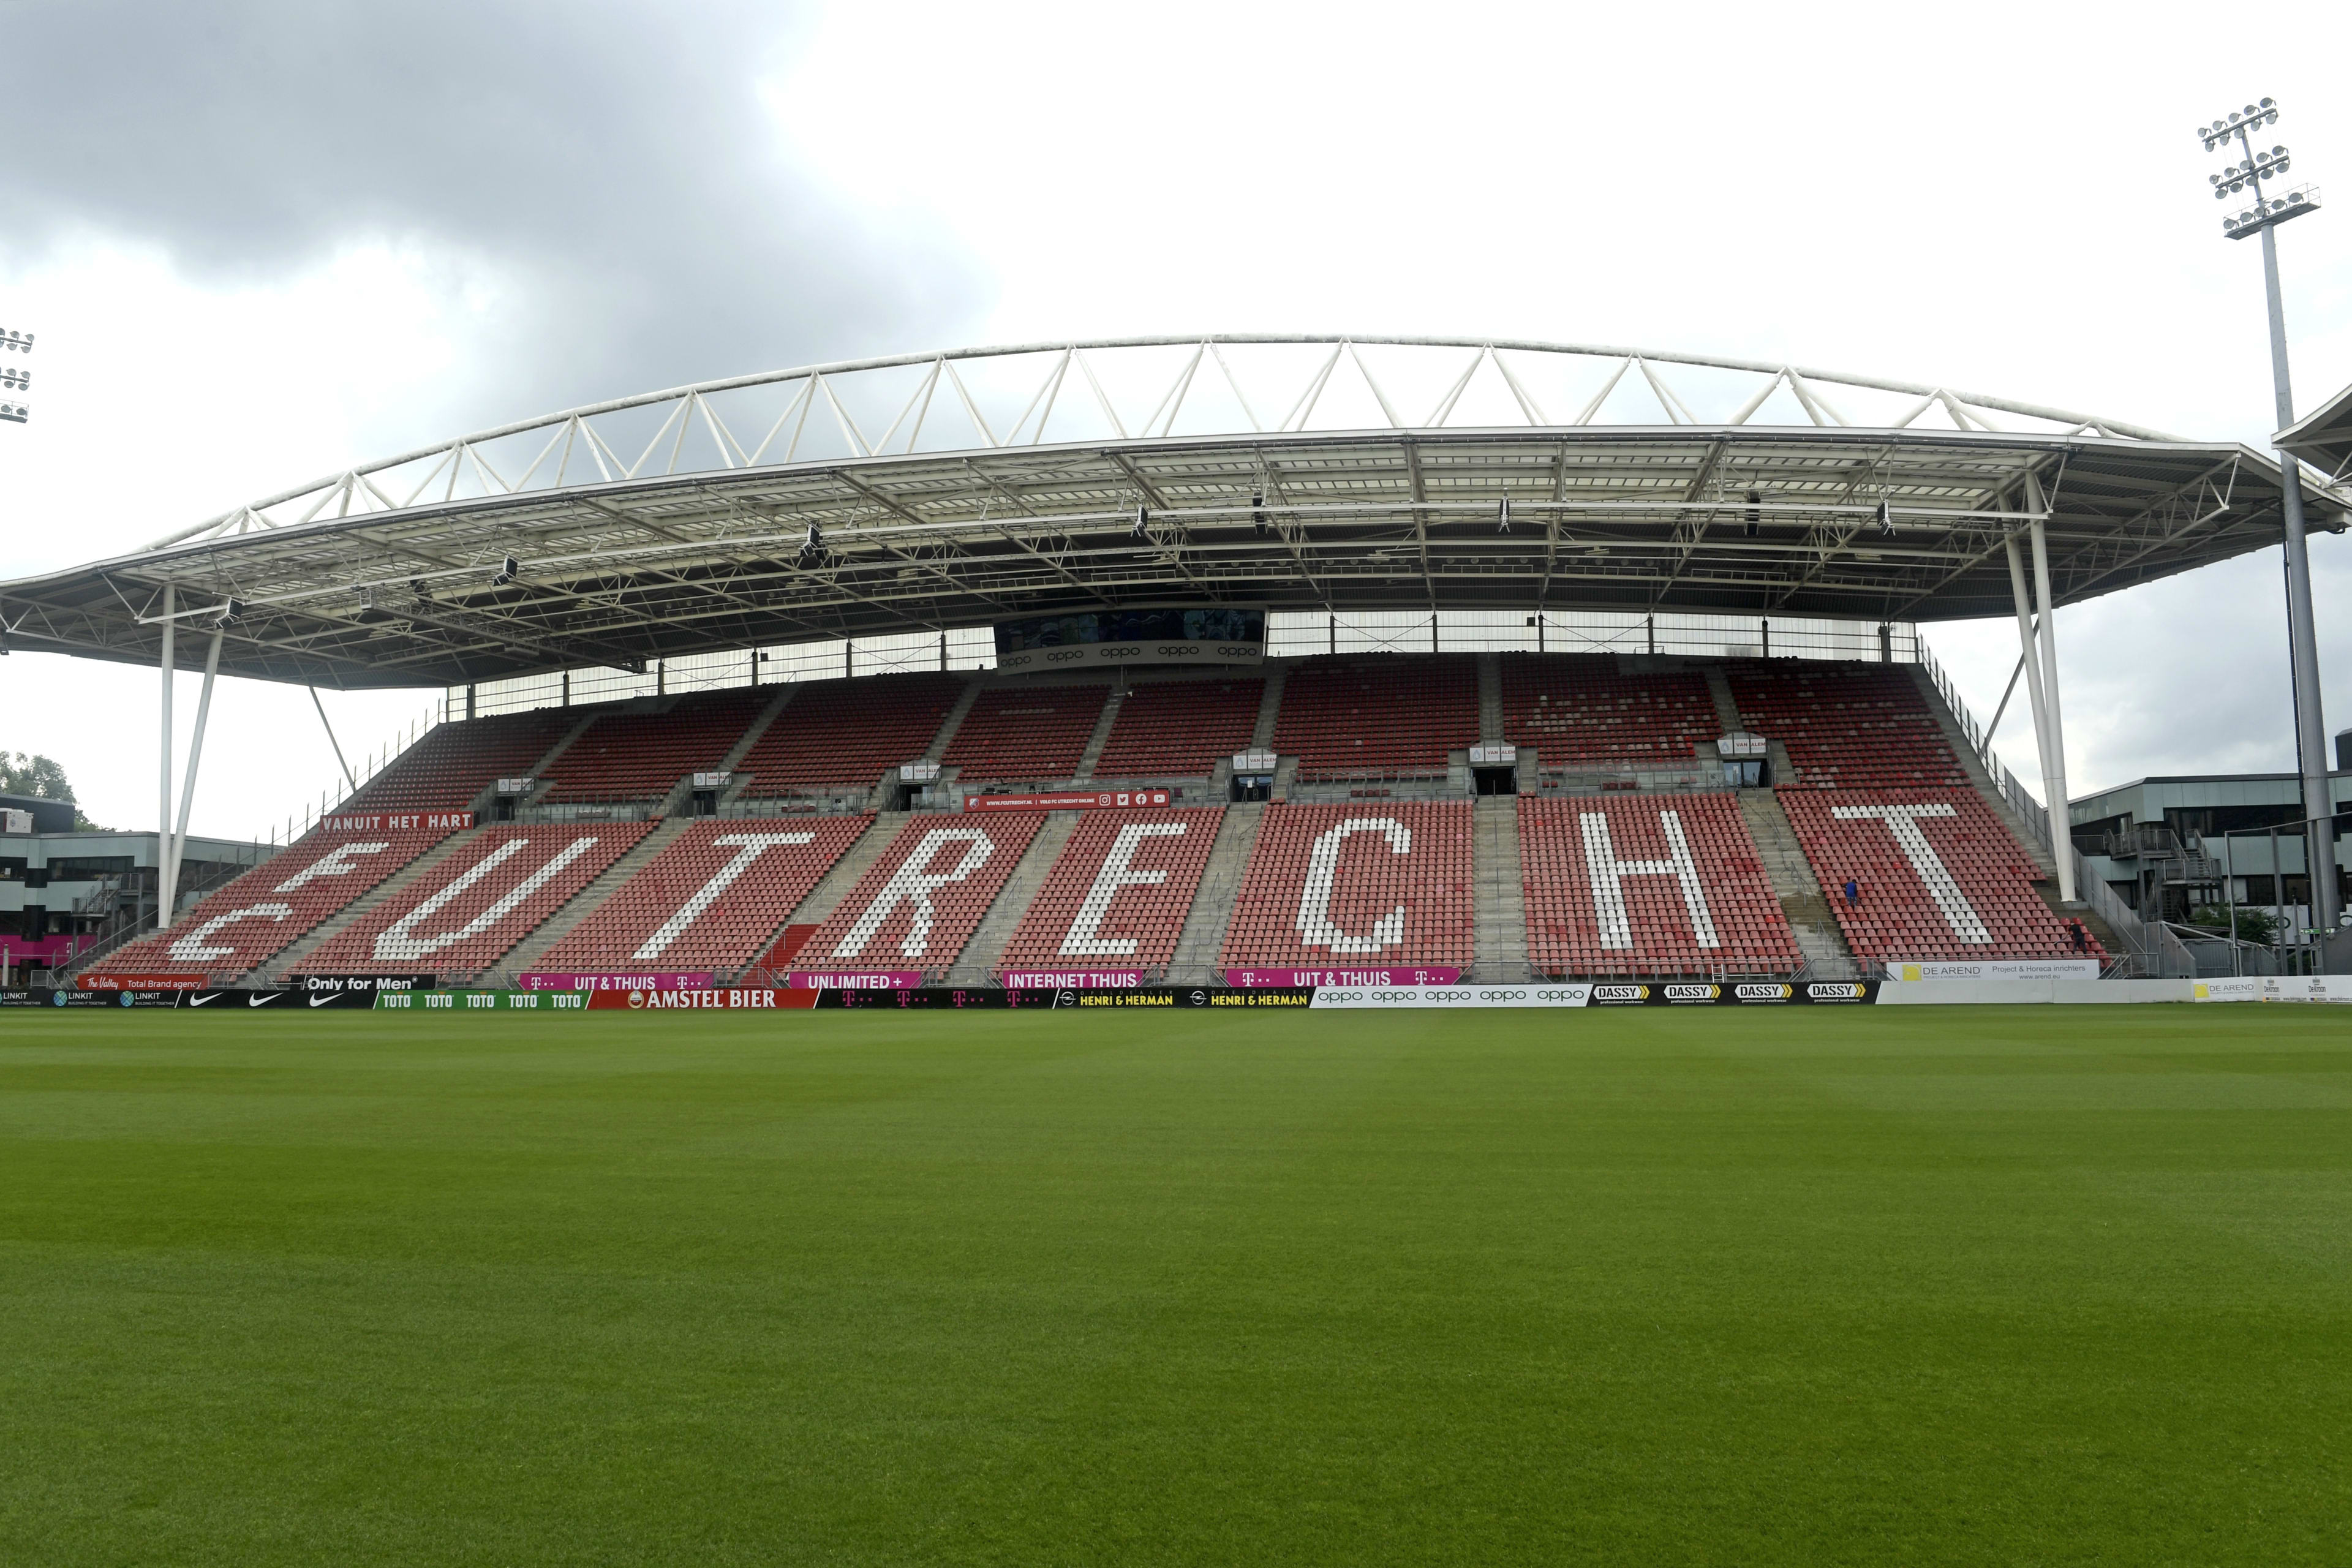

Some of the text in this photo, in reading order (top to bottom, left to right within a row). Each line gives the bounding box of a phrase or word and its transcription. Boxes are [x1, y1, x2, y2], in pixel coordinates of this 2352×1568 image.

[1047, 650, 1084, 662] oppo
[1101, 647, 1140, 658] oppo
[1158, 646, 1199, 657] oppo
[1218, 647, 1257, 658] oppo
[1001, 655, 1031, 668] oppo
[323, 814, 471, 829] VANUIT HET HART
[87, 977, 98, 987] The
[99, 976, 119, 990] Valley
[308, 978, 412, 990] Only for Men
[575, 976, 597, 990] UIT
[600, 976, 610, 990] &
[613, 976, 655, 990] THUIS
[808, 975, 902, 989] UNLIMITED +
[1009, 973, 1137, 988] INTERNET THUIS
[1294, 972, 1321, 986] UIT
[1325, 971, 1335, 986] &
[1340, 971, 1391, 986] THUIS
[1480, 990, 1526, 1002] oppo
[1537, 990, 1584, 1001] oppo
[1599, 987, 1637, 998] DASSY
[1669, 987, 1707, 997] DASSY
[1740, 986, 1779, 996] DASSY
[1812, 985, 1852, 995] DASSY
[383, 995, 411, 1008] TOTO
[425, 995, 453, 1008] TOTO
[466, 995, 494, 1008] TOTO
[509, 995, 537, 1008] TOTO
[552, 995, 581, 1008] TOTO
[647, 990, 776, 1008] AMSTEL BIER
[1080, 995, 1173, 1006] HENRI & HERMAN
[1211, 995, 1307, 1006] HENRI & HERMAN
[1318, 992, 1363, 1003] oppo
[1371, 992, 1417, 1003] oppo
[1425, 991, 1471, 1002] oppo
